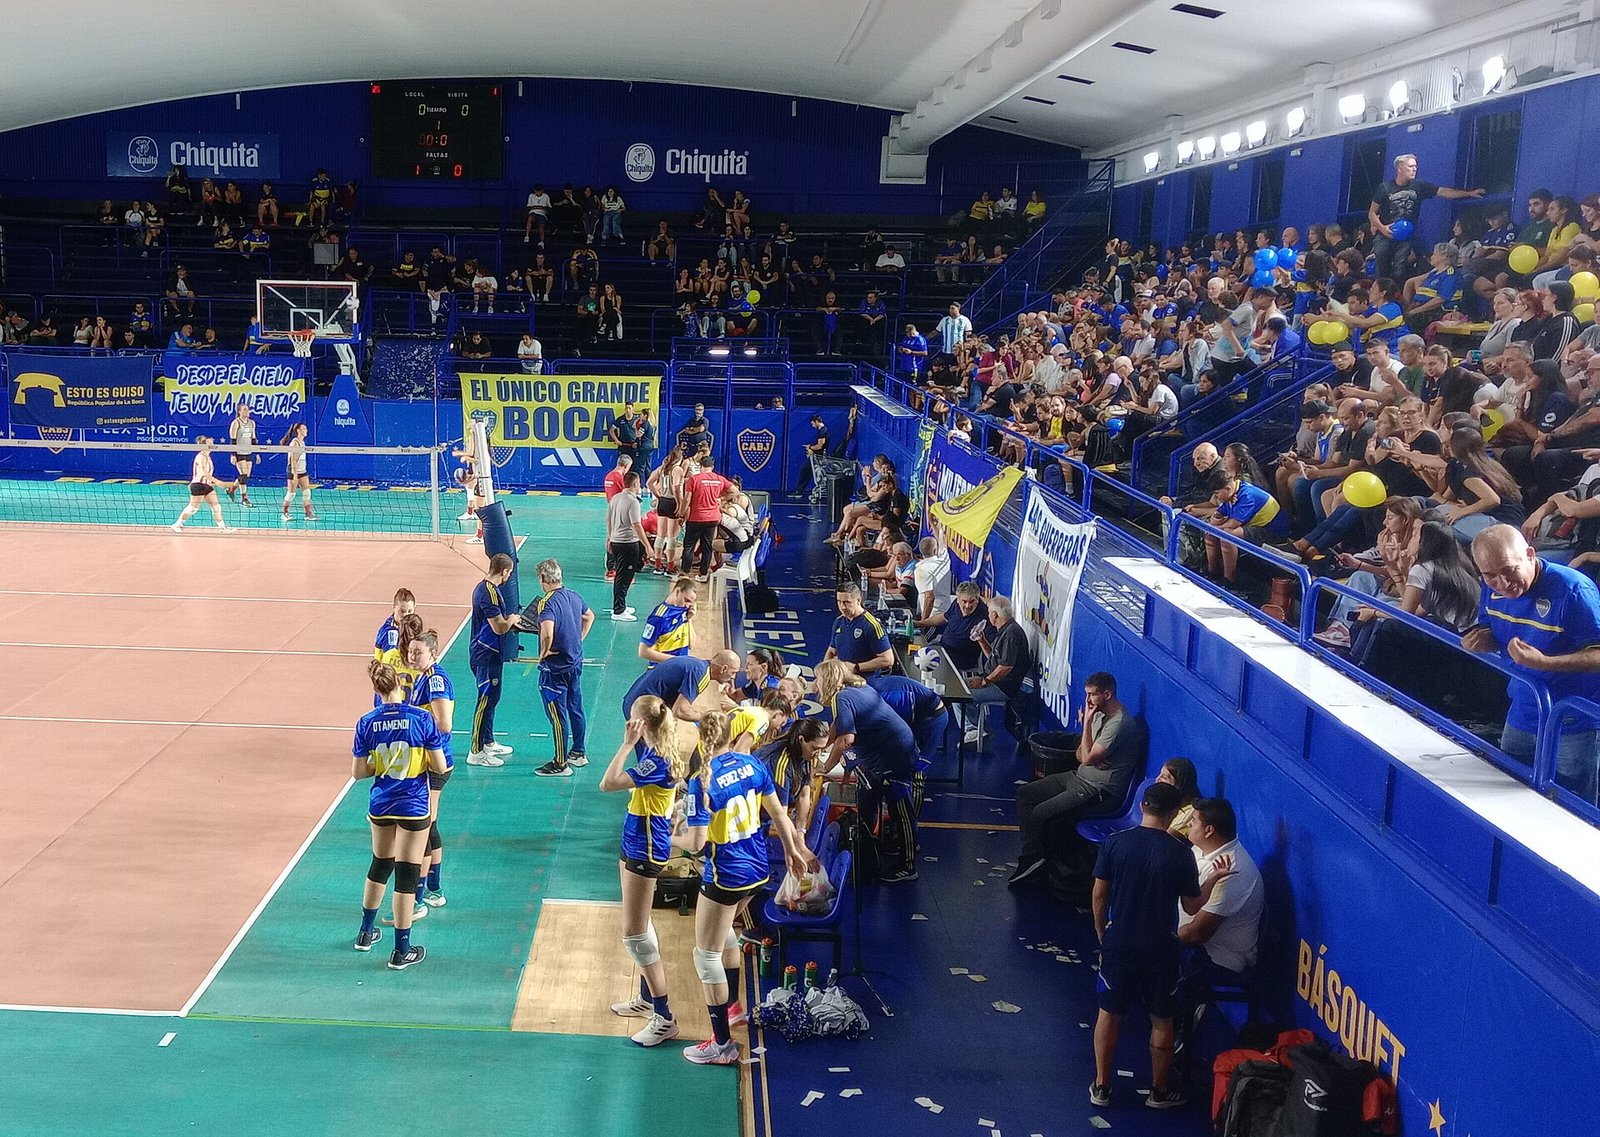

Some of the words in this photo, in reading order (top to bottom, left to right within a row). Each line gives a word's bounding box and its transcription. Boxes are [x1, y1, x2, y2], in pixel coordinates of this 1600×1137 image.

[128, 154, 158, 167] Chiquita
[170, 141, 259, 175] Chiquita
[626, 163, 653, 176] Chiquita
[665, 148, 748, 183] Chiquita
[177, 364, 227, 387] DESDE
[228, 362, 249, 387] EL
[250, 363, 294, 388] CIELO
[66, 386, 94, 399] ESTO
[96, 386, 110, 398] ES
[112, 385, 145, 398] GUISO
[470, 379, 492, 401] EL
[496, 376, 561, 403] ÚNICO
[567, 380, 651, 403] GRANDE
[169, 391, 190, 416] TE
[190, 392, 220, 422] VOY
[221, 392, 234, 416] A
[236, 391, 300, 420] ALENTAR
[334, 416, 356, 428] hiquita
[503, 406, 619, 442] BOCA
[741, 443, 771, 451] CABJ
[1038, 517, 1087, 568] GUERRERAS
[373, 719, 410, 733] OTAMENDI
[716, 769, 740, 789] PEREZ
[727, 788, 761, 843] 21
